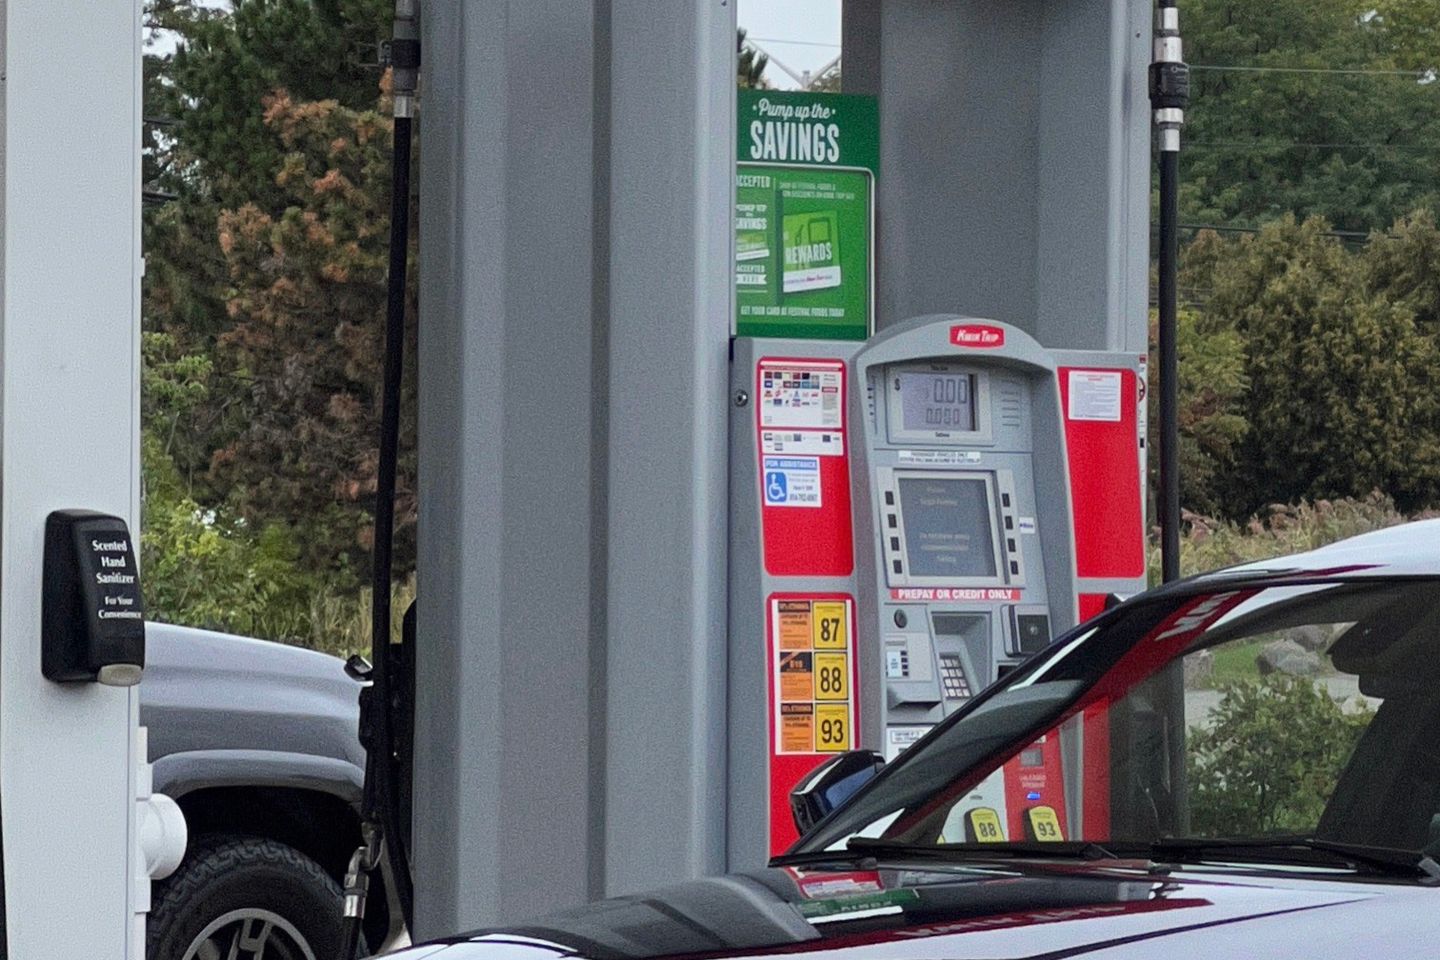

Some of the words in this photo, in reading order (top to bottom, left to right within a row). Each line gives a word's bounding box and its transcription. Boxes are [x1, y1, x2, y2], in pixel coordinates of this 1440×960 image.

[758, 98, 793, 120] Pump
[794, 105, 811, 121] up
[811, 103, 831, 119] the
[750, 120, 839, 163] SAVINGS
[785, 242, 833, 264] REWARDS
[92, 540, 128, 552] Scented
[101, 556, 126, 567] Hand
[96, 572, 134, 584] Sanitizer
[104, 596, 116, 605] For
[117, 595, 133, 605] Your
[898, 588, 933, 599] PREPAY
[936, 589, 950, 599] OR
[952, 589, 986, 599] CREDIT
[988, 590, 1012, 600] ONLY
[820, 618, 840, 642] 87
[820, 667, 842, 693] 88
[821, 719, 844, 744] 93
[979, 822, 997, 837] 88
[1038, 822, 1056, 837] 93
